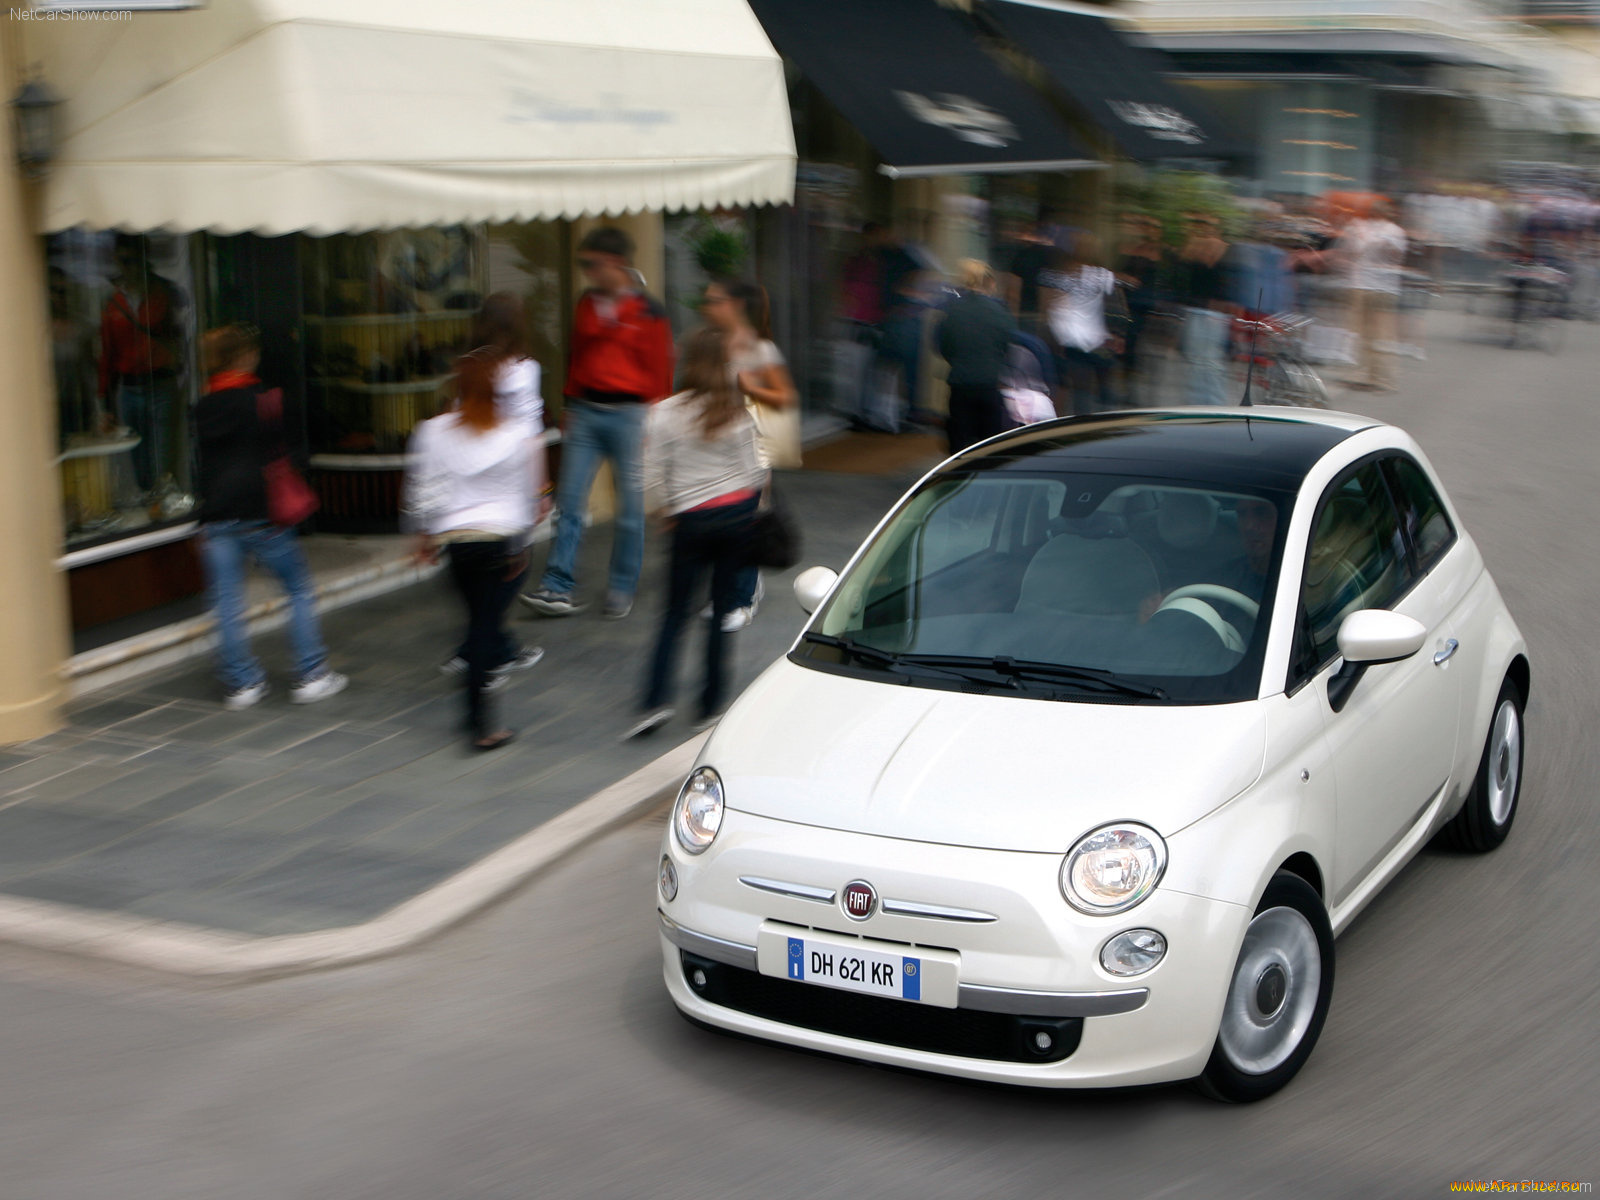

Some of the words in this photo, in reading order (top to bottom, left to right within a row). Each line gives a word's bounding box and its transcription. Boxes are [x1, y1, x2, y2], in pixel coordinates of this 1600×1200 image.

[850, 891, 870, 911] FIAT
[811, 951, 834, 977] DH
[839, 957, 865, 982] 621
[872, 962, 893, 987] KR
